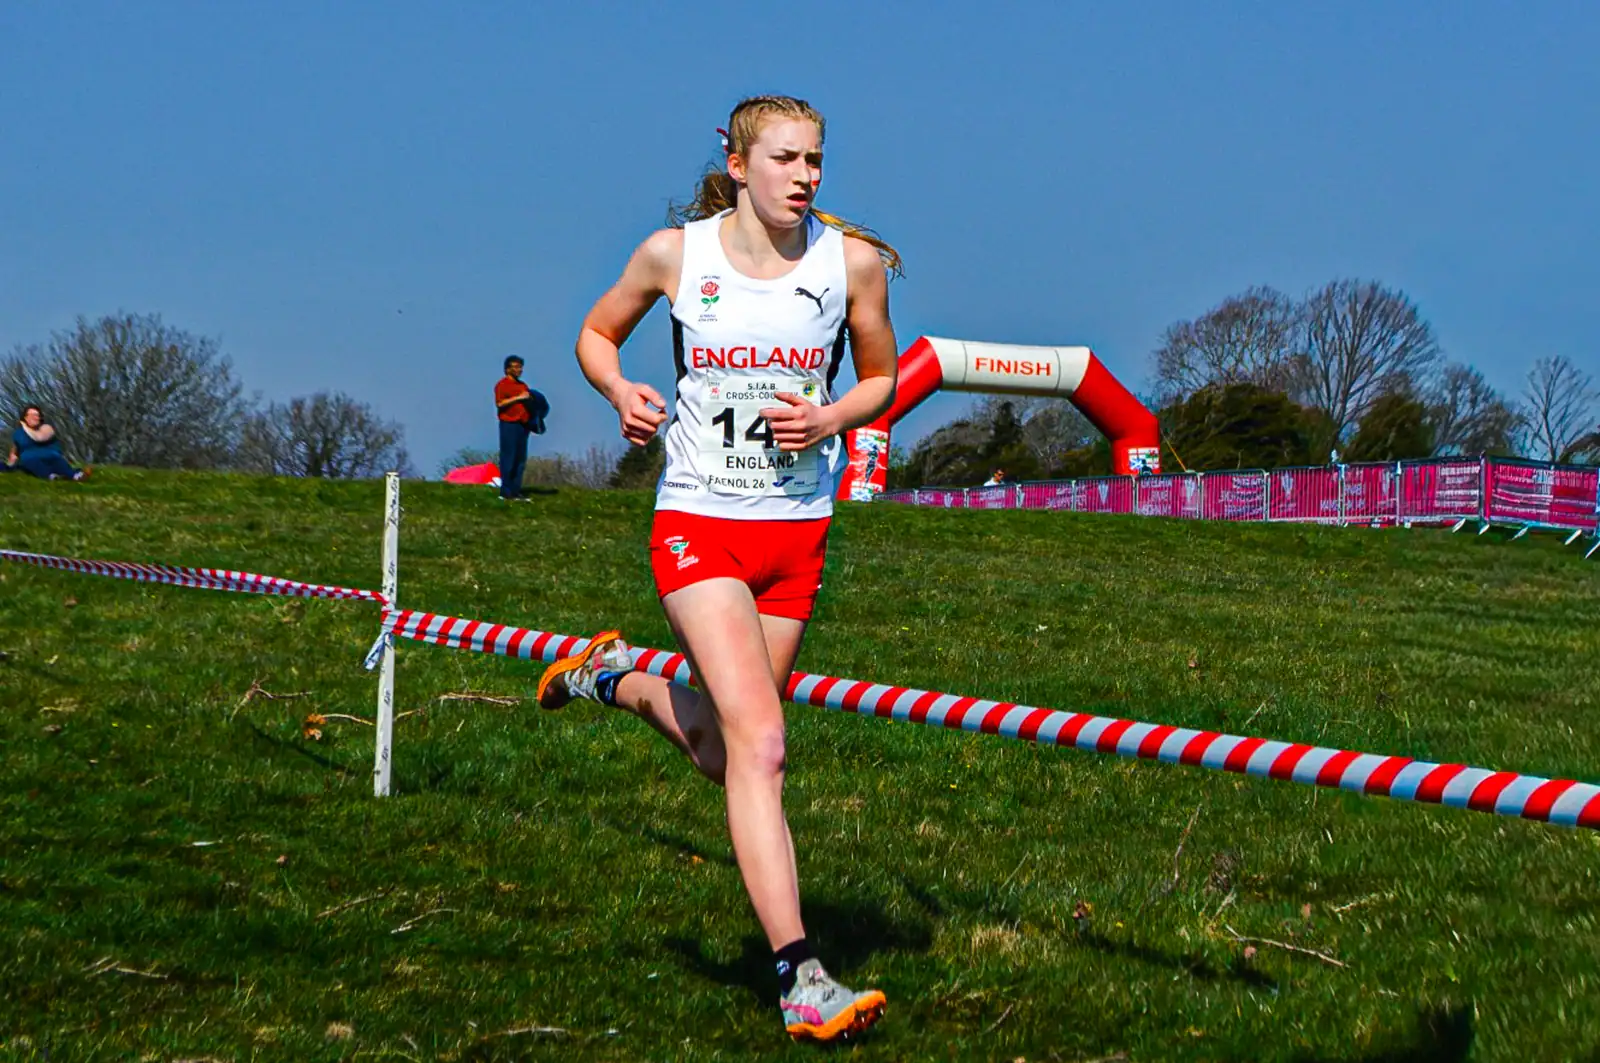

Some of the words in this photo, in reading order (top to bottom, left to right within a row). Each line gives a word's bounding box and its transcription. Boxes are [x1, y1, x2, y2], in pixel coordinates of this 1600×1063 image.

[692, 346, 825, 370] ENGLAND
[975, 357, 1052, 376] FINISH
[725, 455, 795, 470] ENGLAND
[752, 478, 765, 489] 26
